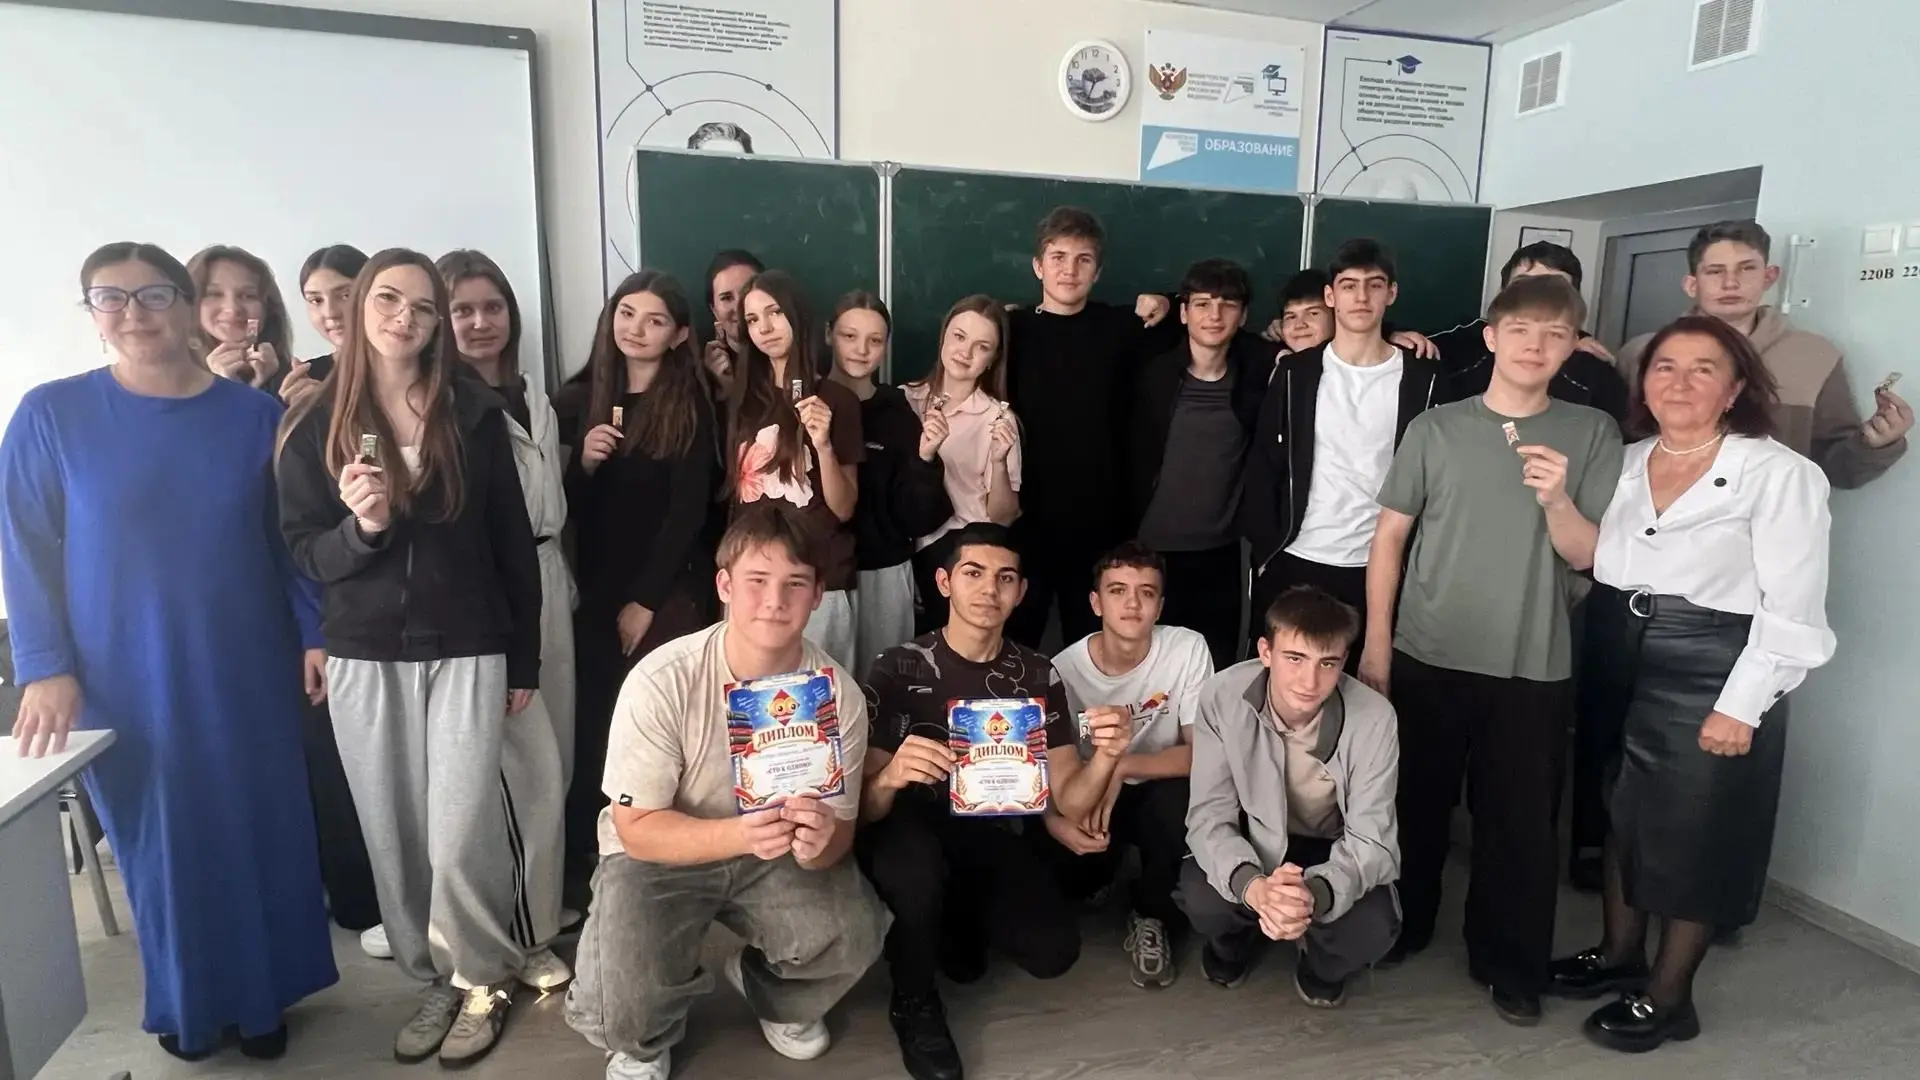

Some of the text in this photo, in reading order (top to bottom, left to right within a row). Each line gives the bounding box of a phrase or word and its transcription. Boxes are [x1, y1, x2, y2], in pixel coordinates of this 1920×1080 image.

[1092, 49, 1099, 57] 12
[1204, 138, 1294, 157] ОБРАЗОВАНИЕ
[1860, 265, 1920, 281] 220В 22
[757, 725, 815, 748] ДИПЛОМ
[973, 745, 1024, 760] ДИПЛОМ
